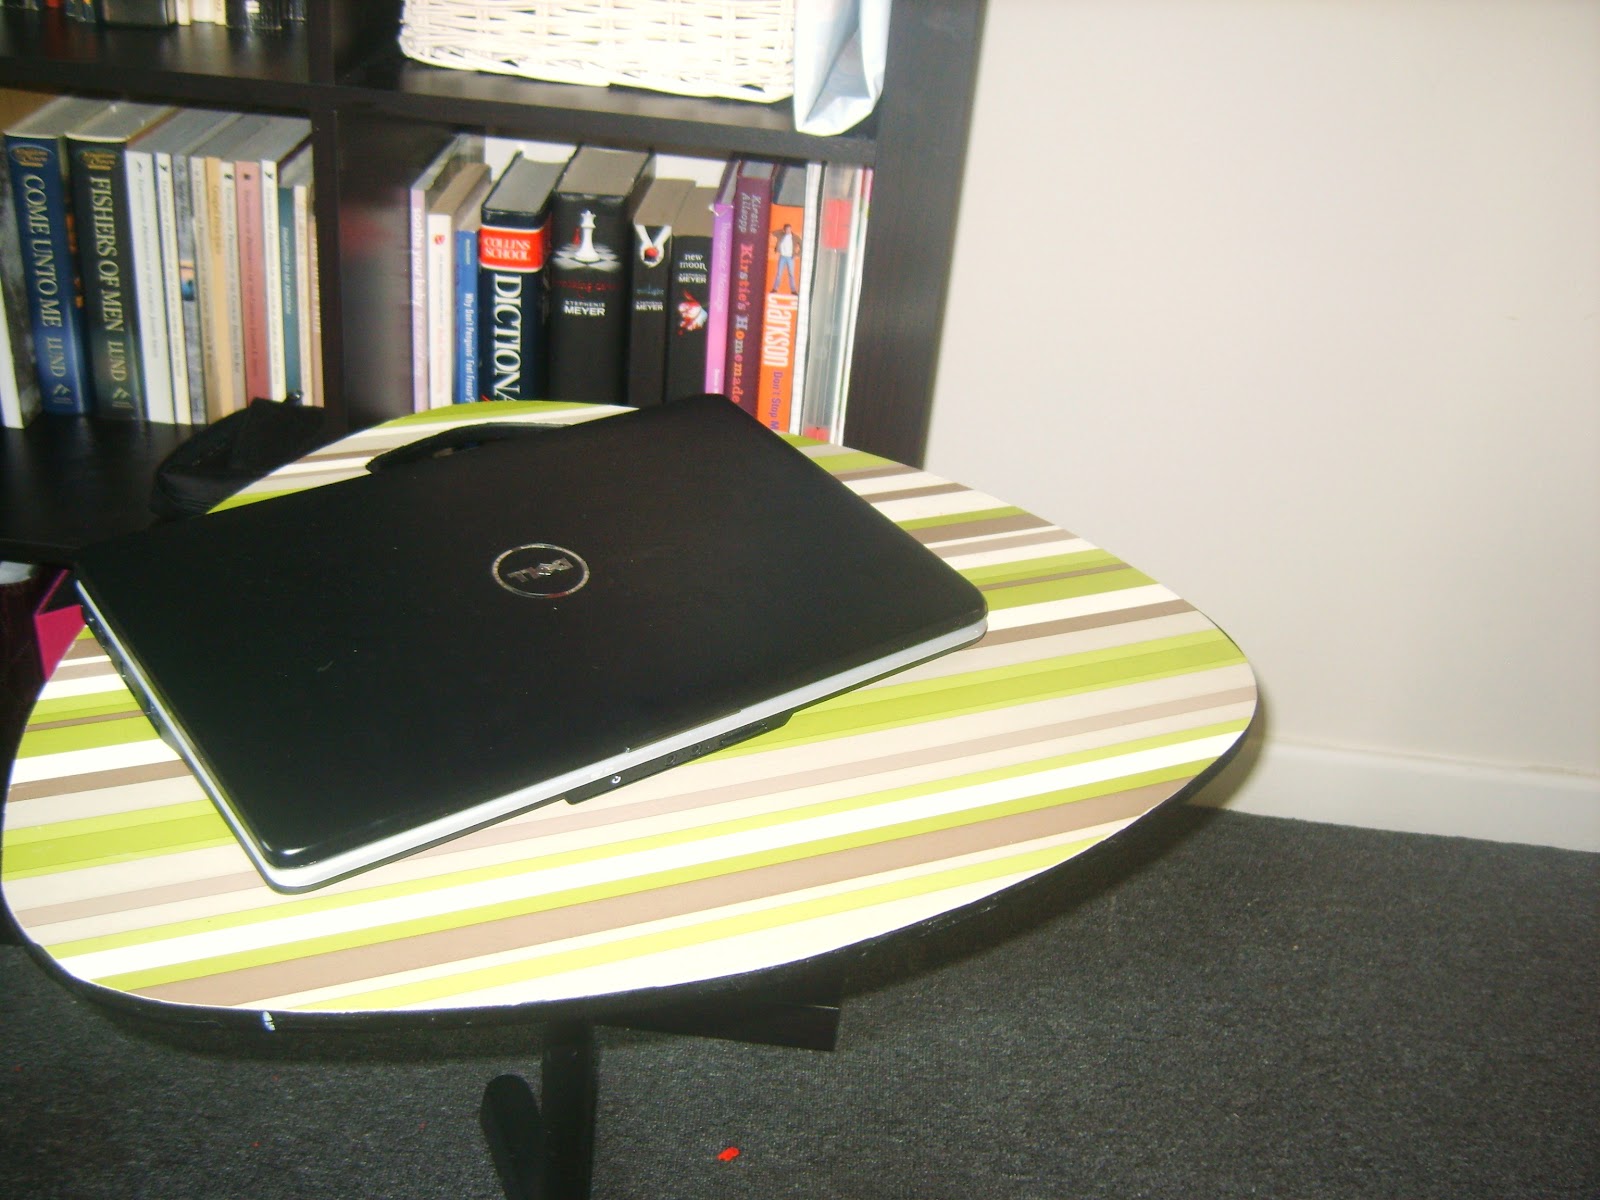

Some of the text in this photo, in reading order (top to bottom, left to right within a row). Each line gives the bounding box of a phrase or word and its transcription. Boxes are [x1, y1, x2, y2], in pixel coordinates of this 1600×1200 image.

[24, 174, 51, 235] COME
[90, 176, 116, 257] FISHERS
[740, 192, 750, 234] Allsopp
[750, 194, 762, 235] Kirstie
[414, 208, 424, 248] soothe
[484, 236, 531, 250] COLLINS
[484, 249, 531, 262] SCHOOL
[32, 238, 60, 296] UNTO
[412, 250, 424, 278] your
[679, 260, 708, 272] moon
[684, 254, 704, 262] new
[98, 260, 120, 287] OF
[413, 280, 425, 308] baby
[463, 292, 474, 308] Why
[636, 304, 664, 312] MEYER
[40, 298, 62, 328] ME
[102, 290, 125, 332] MEN
[564, 306, 606, 316] MEYER
[732, 243, 756, 404] Kirstie's Homemade
[764, 294, 799, 368] Clarkson
[46, 336, 67, 377] LUND
[108, 340, 128, 382] LUND
[772, 370, 784, 398] Don't
[770, 396, 781, 418] Stop
